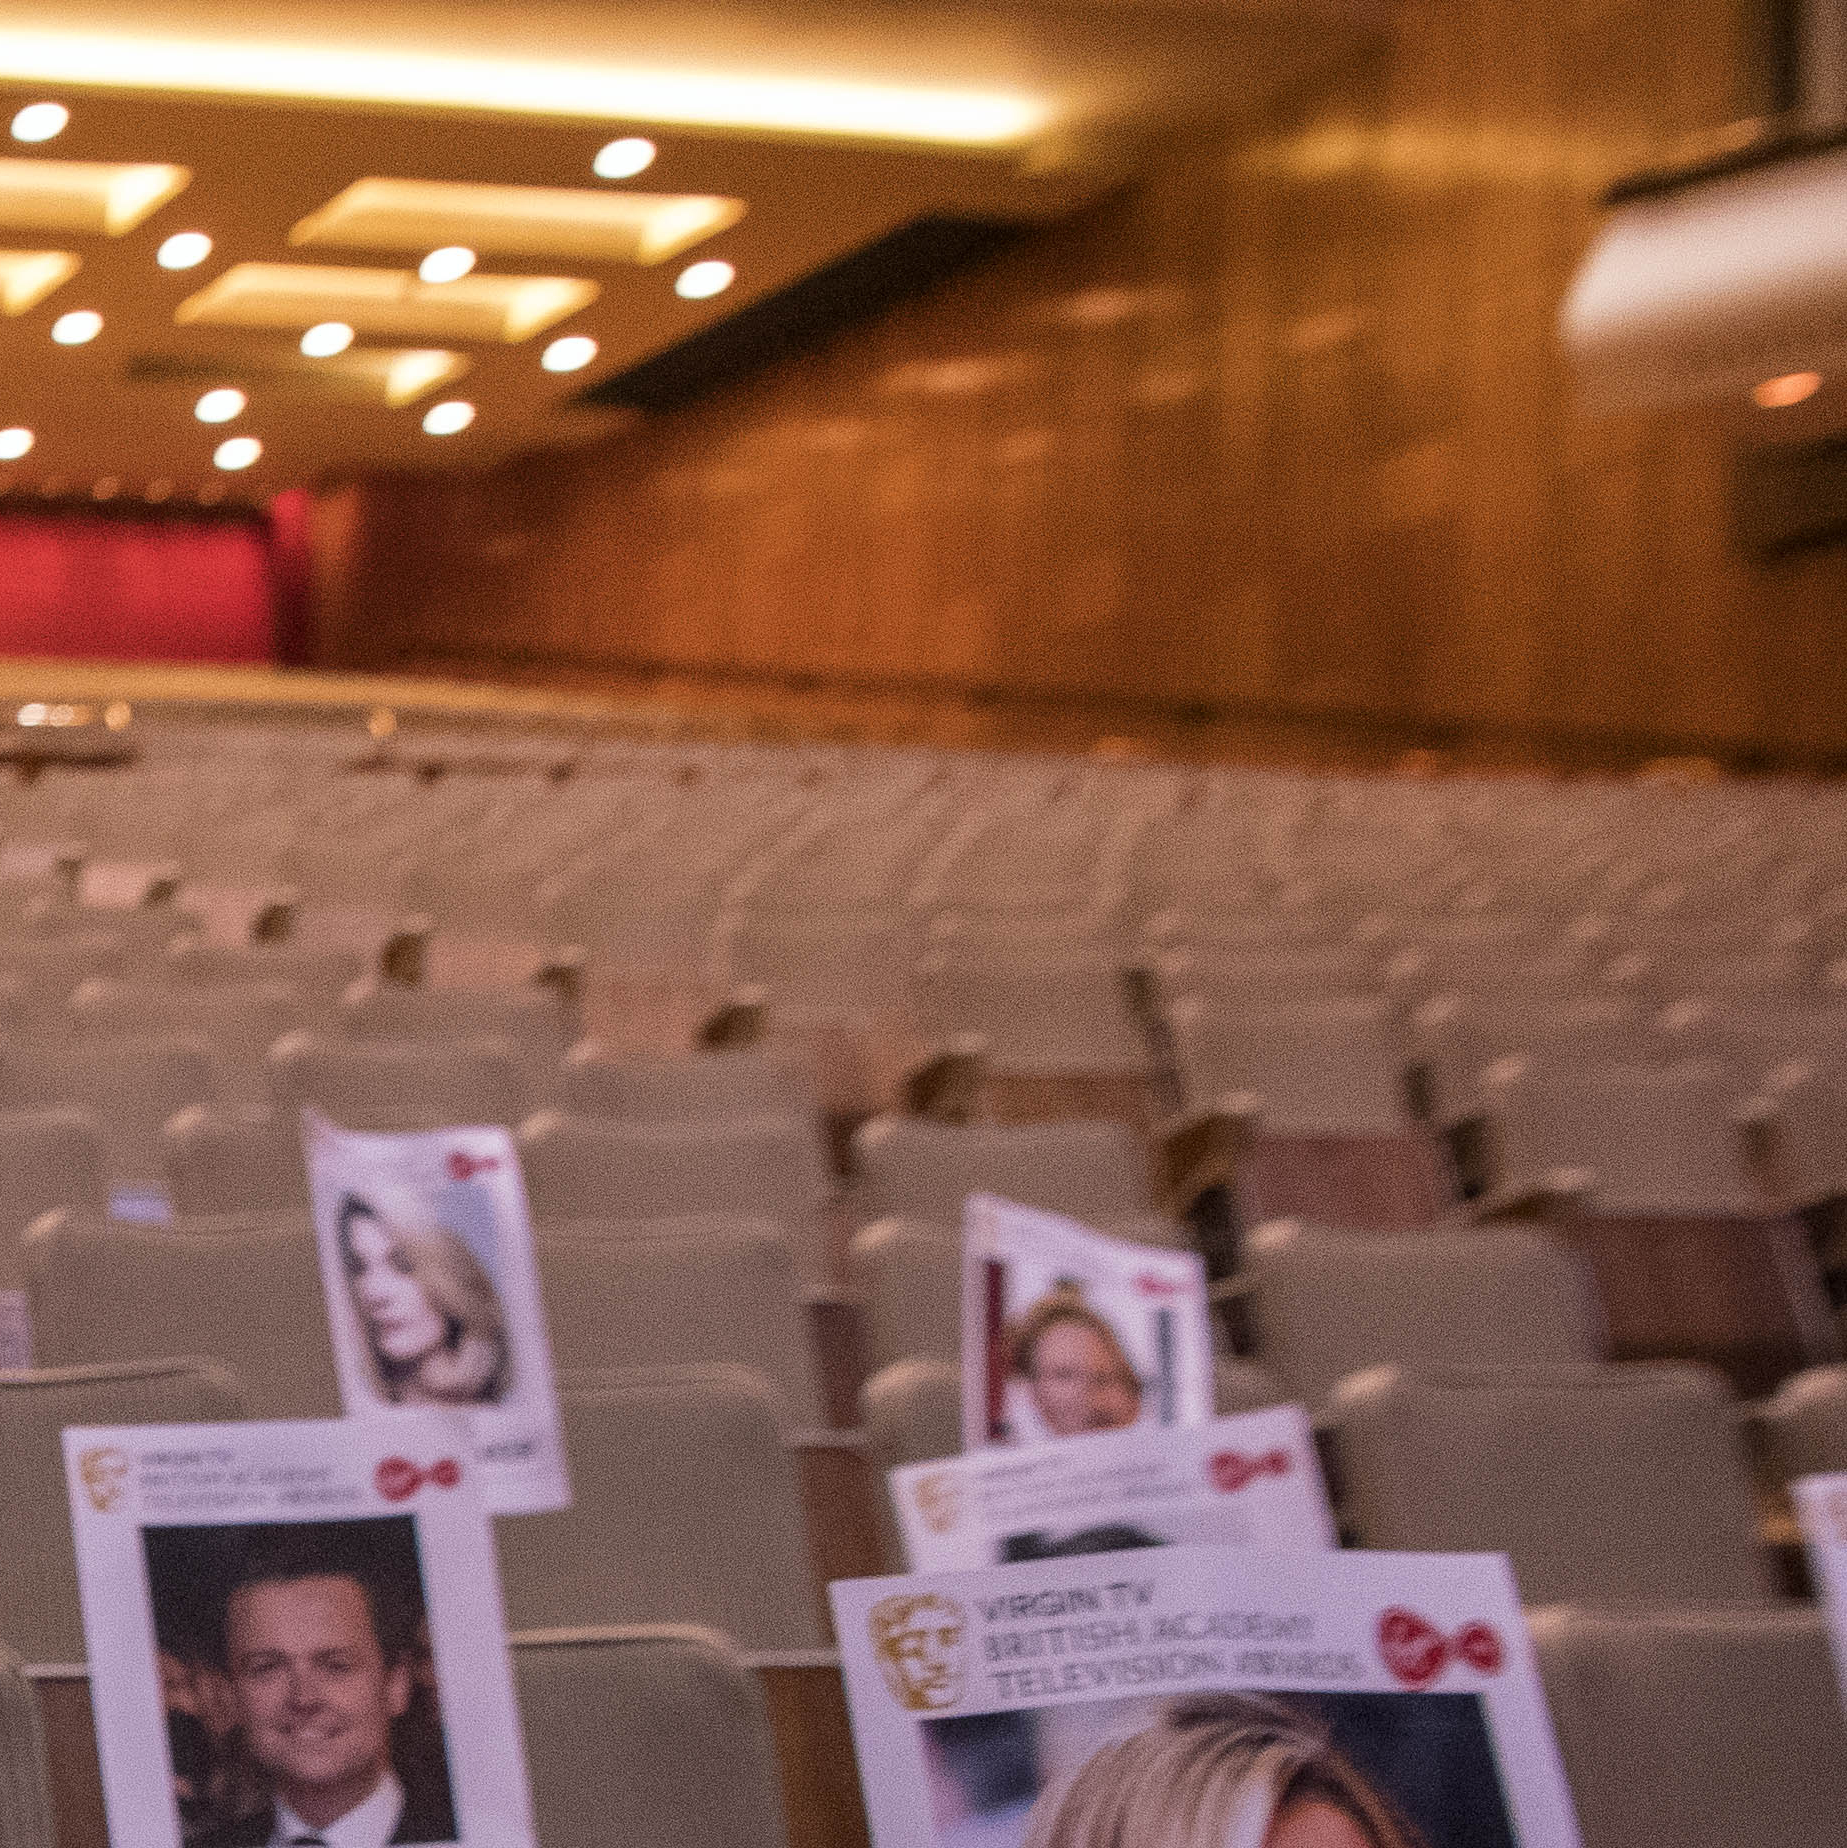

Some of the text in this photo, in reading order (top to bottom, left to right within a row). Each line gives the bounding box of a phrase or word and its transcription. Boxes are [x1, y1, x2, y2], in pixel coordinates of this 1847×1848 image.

[978, 1580, 1155, 1624] VIRGIN TV
[983, 1621, 1141, 1663] BRITISH
[991, 1652, 1224, 1699] TELEVISION
